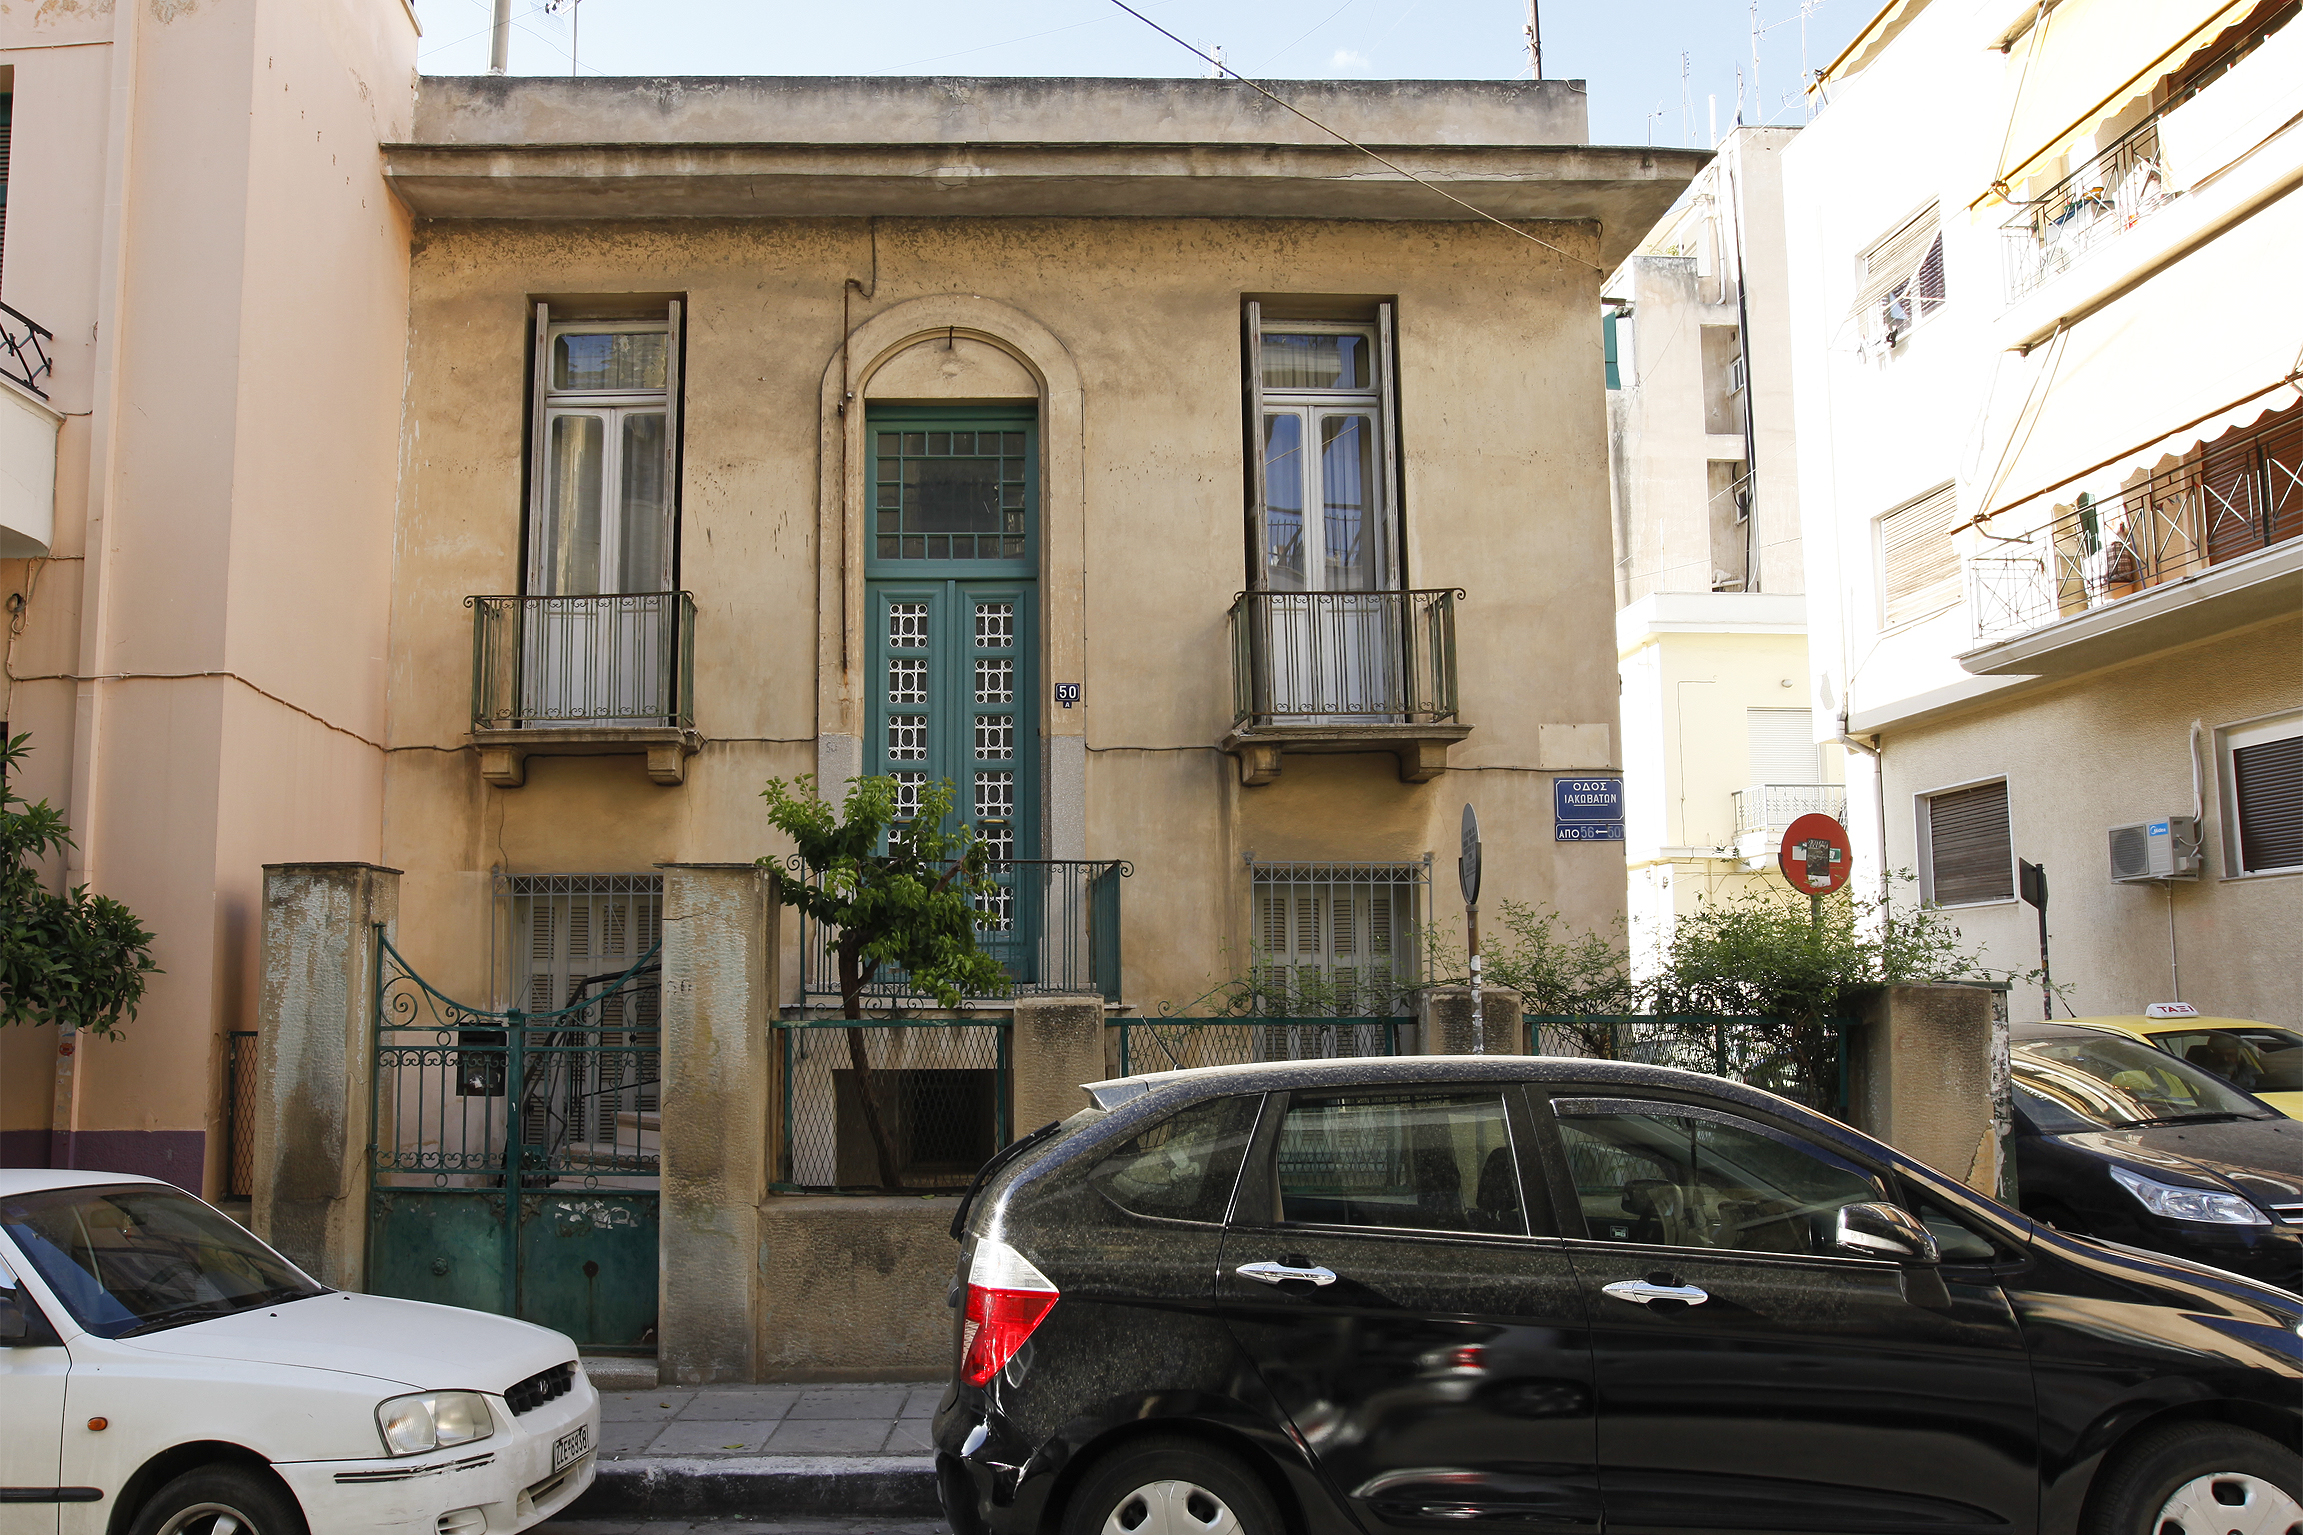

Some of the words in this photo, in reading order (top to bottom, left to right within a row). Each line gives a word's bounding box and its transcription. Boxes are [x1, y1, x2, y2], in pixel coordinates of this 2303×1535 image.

[1059, 685, 1077, 699] 50
[1572, 782, 1608, 792] ΟΔΟΣ
[1564, 793, 1617, 804] ΙΑΚΩΒΑΤΩΝ
[1558, 829, 1580, 839] ΑΠΟ
[1580, 826, 1595, 839] 56
[2156, 1005, 2195, 1013] ΤΑΞΙ
